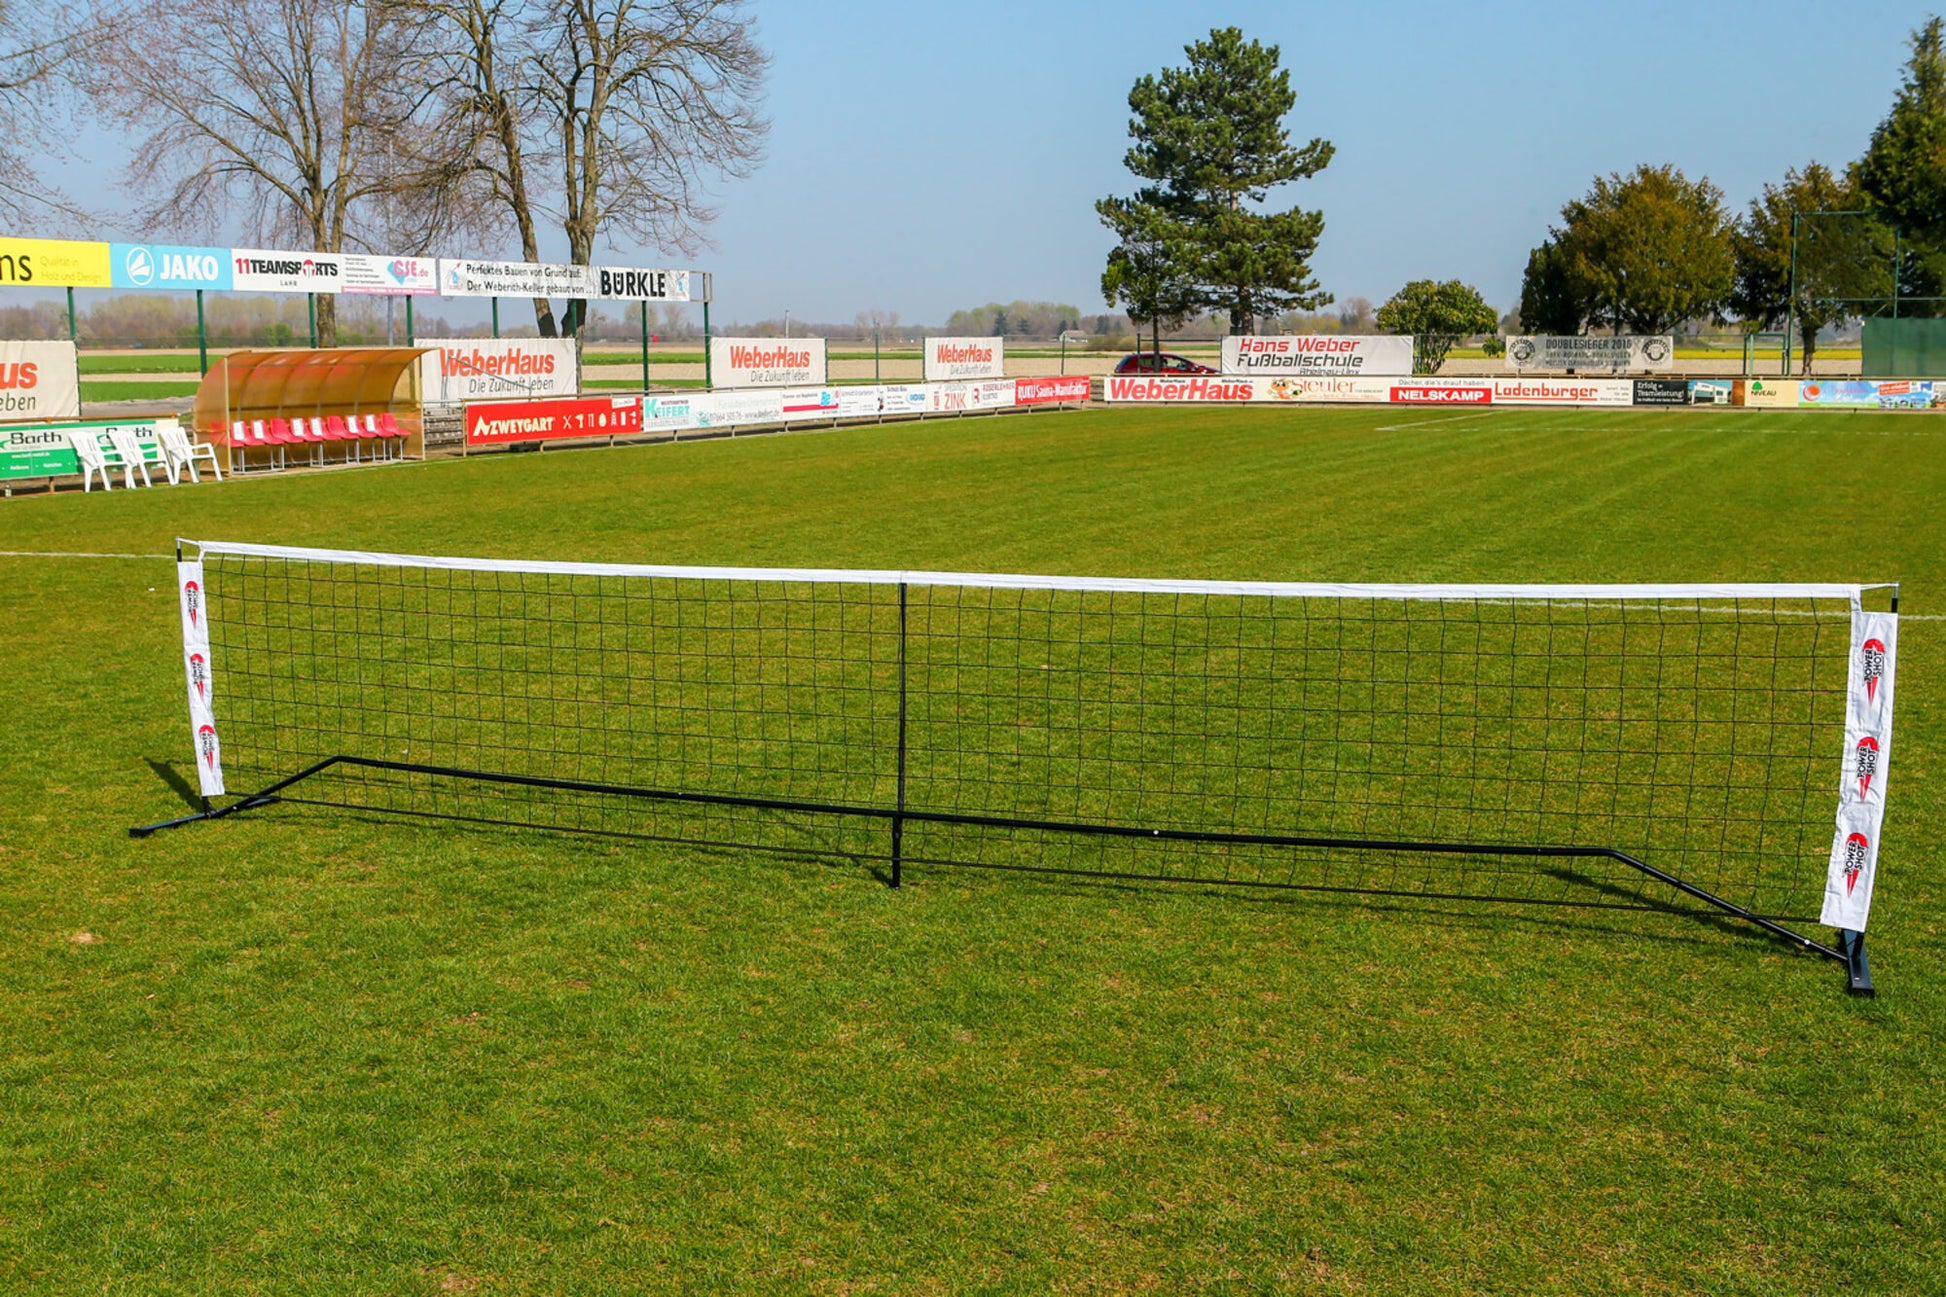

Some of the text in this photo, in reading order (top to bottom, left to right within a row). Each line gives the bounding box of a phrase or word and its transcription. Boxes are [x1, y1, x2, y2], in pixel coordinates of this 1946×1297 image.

[160, 253, 219, 281] JAKO
[466, 264, 503, 276] Perfektes
[505, 267, 528, 276] Bauen
[545, 267, 568, 278] Grund
[466, 281, 481, 291] Der
[600, 270, 666, 297] BÜRKLE
[937, 343, 992, 364] WeberHaus
[1239, 338, 1361, 352] Hans Weber
[1545, 338, 1609, 350] DOUBLESIEGER
[439, 347, 556, 377] WeberHaus
[730, 345, 811, 369] WeberHaus
[1237, 353, 1363, 368] Fußballschule
[469, 378, 486, 394] Die
[489, 377, 526, 393] Zukunft
[750, 370, 810, 383] Die Zukunft leben
[1637, 382, 1657, 391] Erfolg
[1110, 378, 1253, 400] WeberHaus
[1398, 390, 1485, 401] NELSKAMP
[1494, 382, 1598, 401] Ladenburger
[645, 398, 690, 418] KEIFERT
[944, 393, 966, 409] ZINK
[10, 432, 62, 445] Barth
[1863, 650, 1873, 681] POWER
[1873, 651, 1882, 676] SHOT
[1857, 747, 1867, 778] POWER
[1867, 749, 1876, 774] SHOT
[1844, 842, 1857, 873] POWER
[1854, 844, 1864, 870] SHOT
